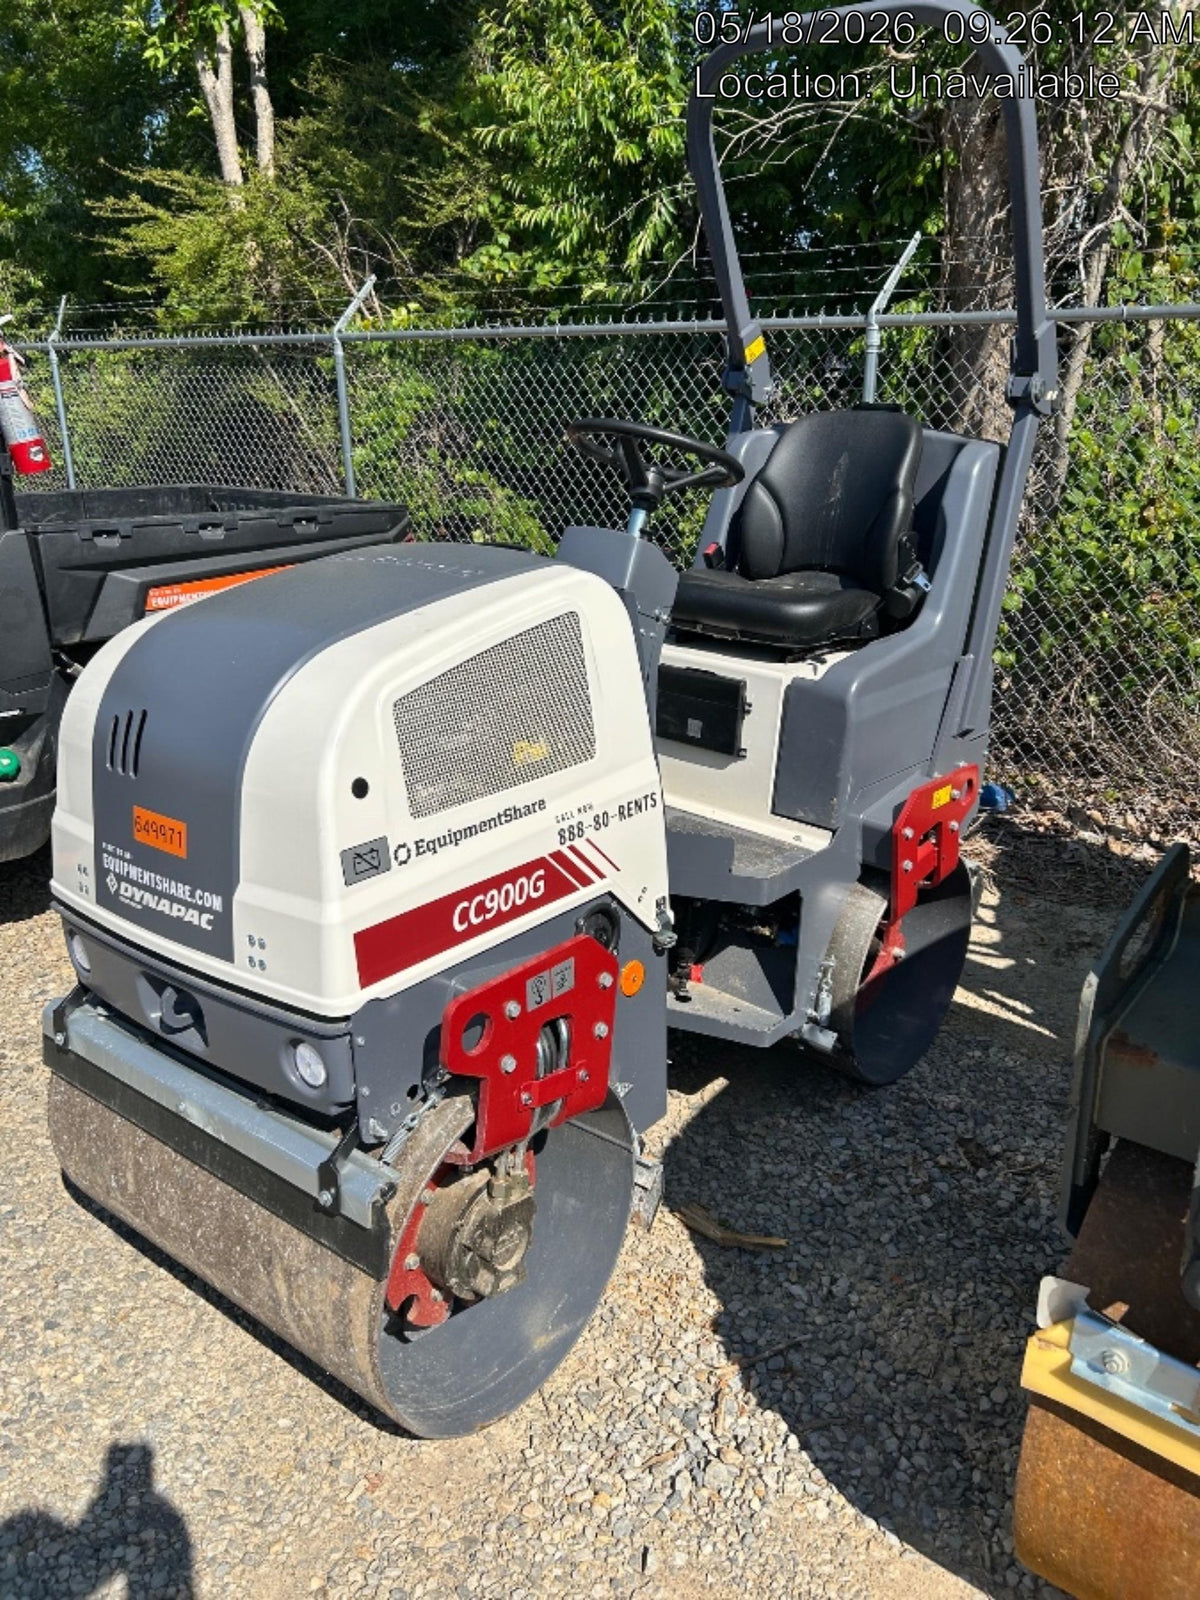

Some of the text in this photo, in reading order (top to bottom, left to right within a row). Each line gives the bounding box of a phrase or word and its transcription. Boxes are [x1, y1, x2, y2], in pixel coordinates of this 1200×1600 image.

[413, 798, 548, 858] EquipmentShare
[557, 791, 657, 846] 888-80-RENTS
[102, 852, 223, 913] EQUIPMENTSHARE.COM
[119, 880, 215, 932] DYNAPAC
[452, 868, 546, 933] CC900G
